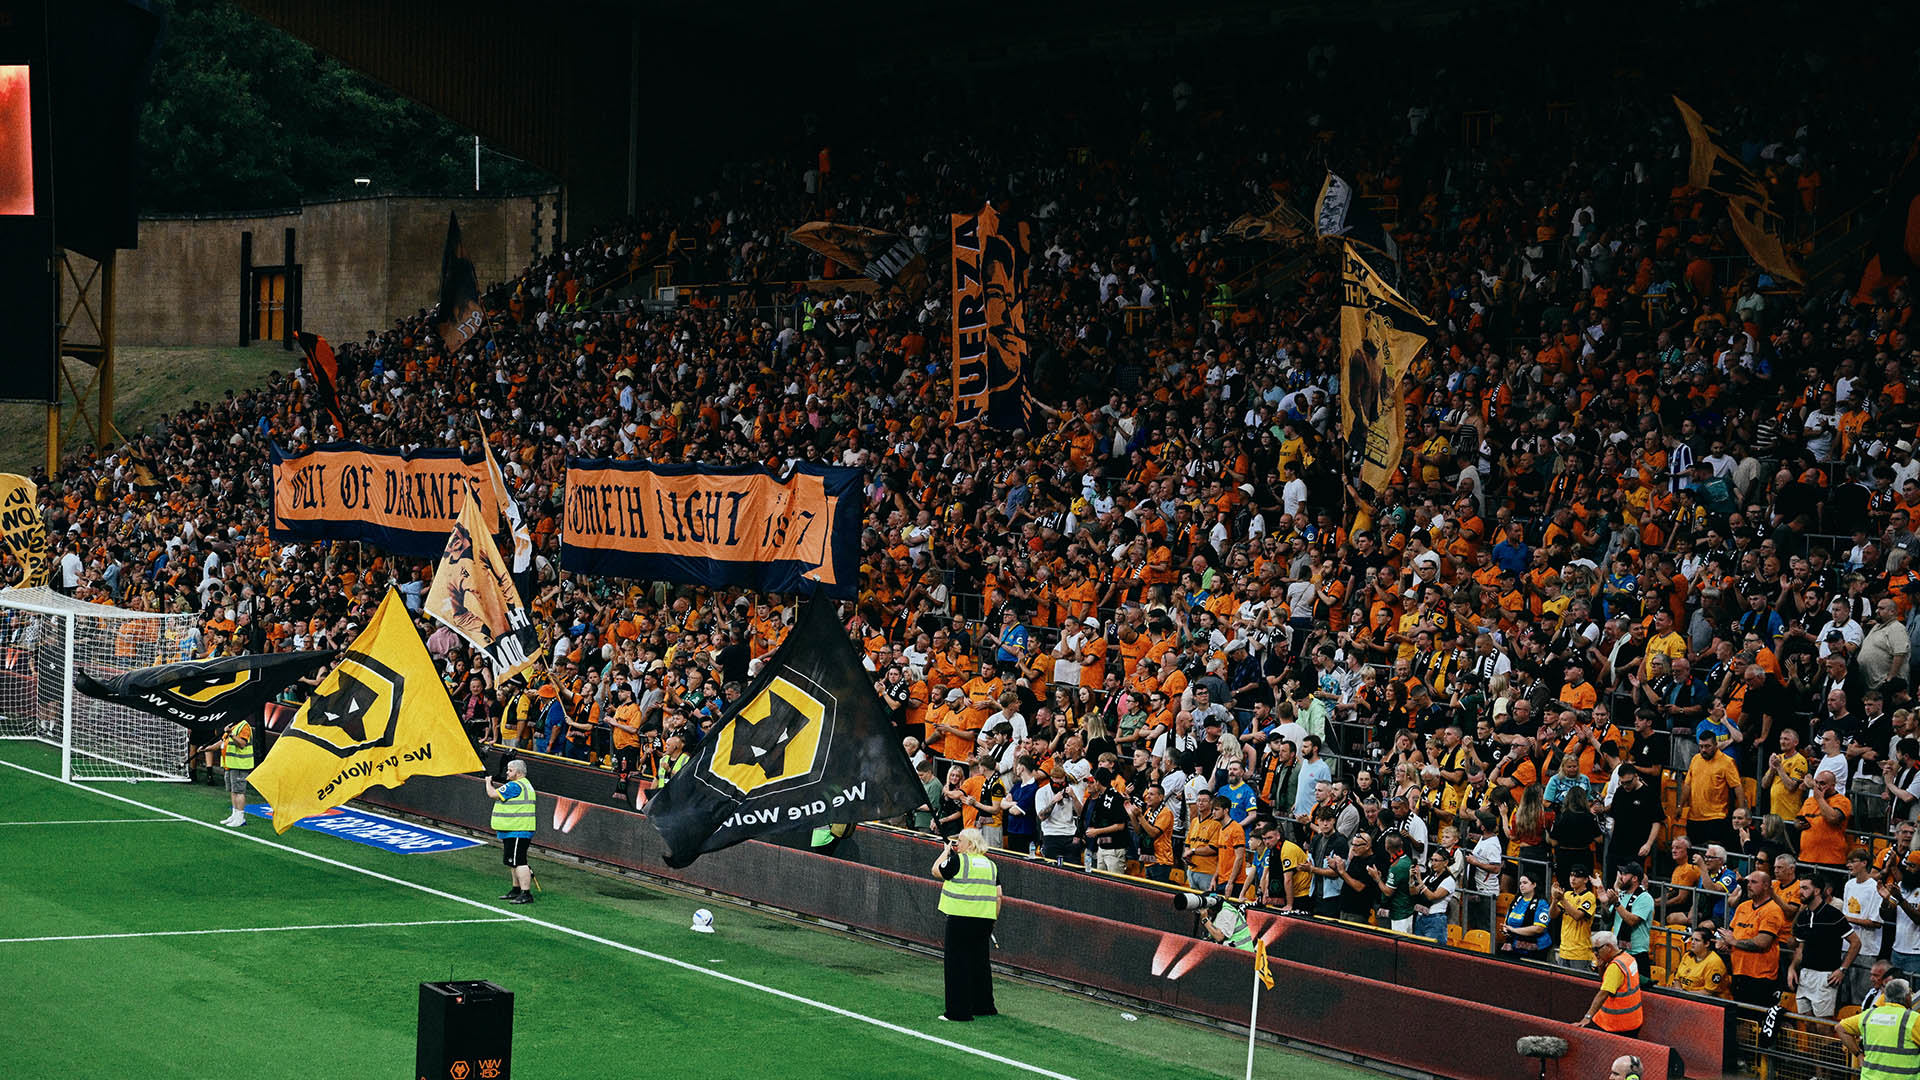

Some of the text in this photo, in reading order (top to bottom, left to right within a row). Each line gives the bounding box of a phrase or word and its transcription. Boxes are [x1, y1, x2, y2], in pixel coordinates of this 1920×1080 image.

[954, 215, 988, 426] FUERZA
[341, 464, 373, 509] OF
[655, 488, 749, 546] LIGHT
[762, 510, 816, 548] 187
